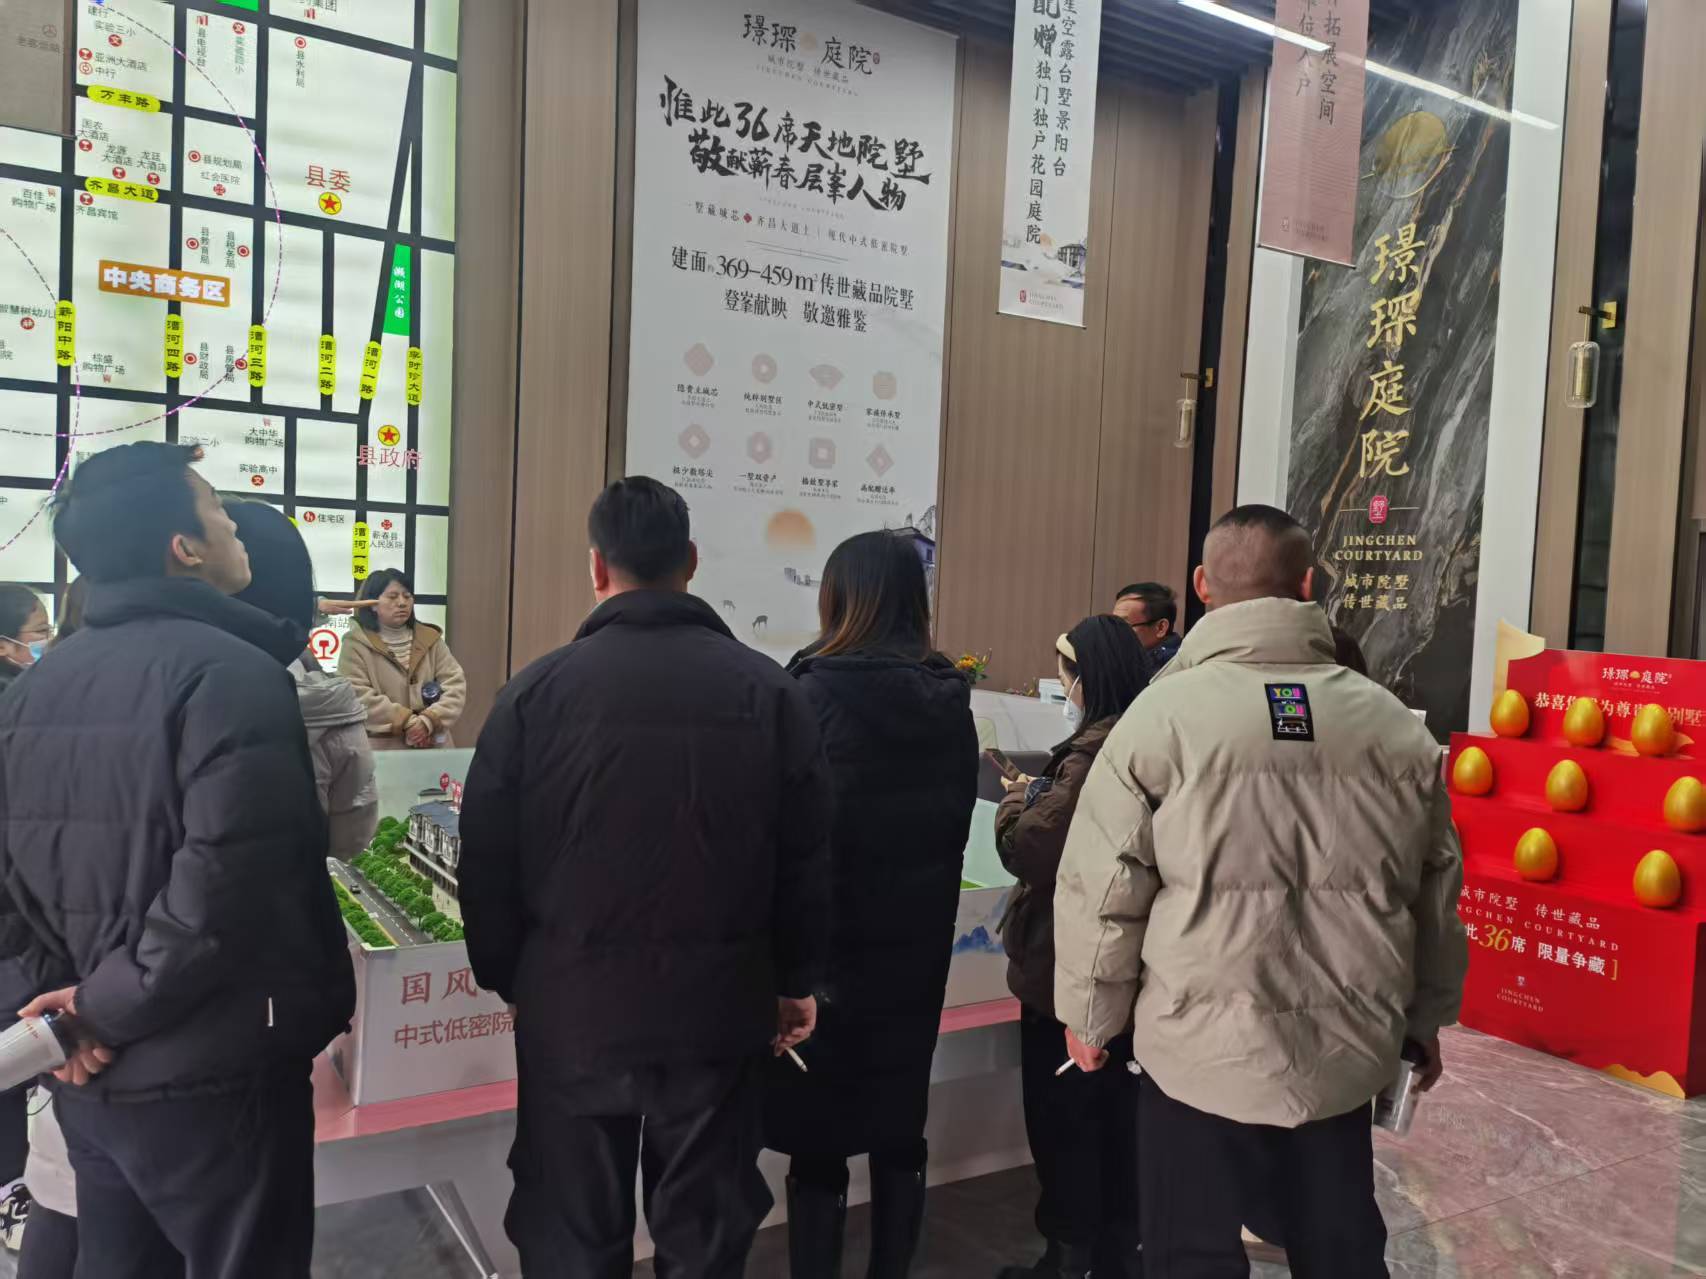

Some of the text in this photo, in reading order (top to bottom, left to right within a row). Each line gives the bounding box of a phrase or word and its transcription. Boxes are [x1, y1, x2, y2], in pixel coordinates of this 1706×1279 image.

[95, 52, 147, 71] 亚洲大酒店
[1319, 0, 1341, 125] 拓展空间
[96, 67, 116, 79] 中行
[100, 90, 150, 108] 万丰路
[77, 129, 109, 143] 大酒店
[103, 154, 134, 167] 大酒店
[137, 160, 167, 173] 大酒店
[305, 165, 350, 193] 县委
[89, 179, 155, 200] 齐昌大道
[12, 197, 56, 213] 购物广场
[103, 266, 225, 302] 中央商务区
[0, 304, 56, 319] 智慧树幼儿
[167, 320, 180, 372] 漕河四路
[250, 331, 264, 381] 漕河三路
[320, 341, 333, 389] 漕河二路
[82, 362, 125, 376] 购物广场
[361, 347, 379, 394] 漕河一路
[408, 351, 421, 403] 李时珍大道
[245, 435, 284, 448] 购物广场
[249, 427, 278, 438] 大中华
[357, 445, 423, 470] 县政府
[239, 463, 278, 474] 实验高中
[317, 514, 345, 524] 住宅区
[1343, 535, 1417, 547] JINGCHEN
[354, 527, 367, 574] 漕河一路
[1334, 550, 1423, 561] COURTYARD
[1344, 573, 1409, 590] 城市院墅
[1344, 593, 1408, 611] 传世藏品
[1536, 903, 1600, 931] 传世藏品
[1457, 903, 1619, 951] NGCHEN COURTYARD
[1464, 922, 1526, 953] 此36席
[1538, 942, 1605, 976] 限量争藏
